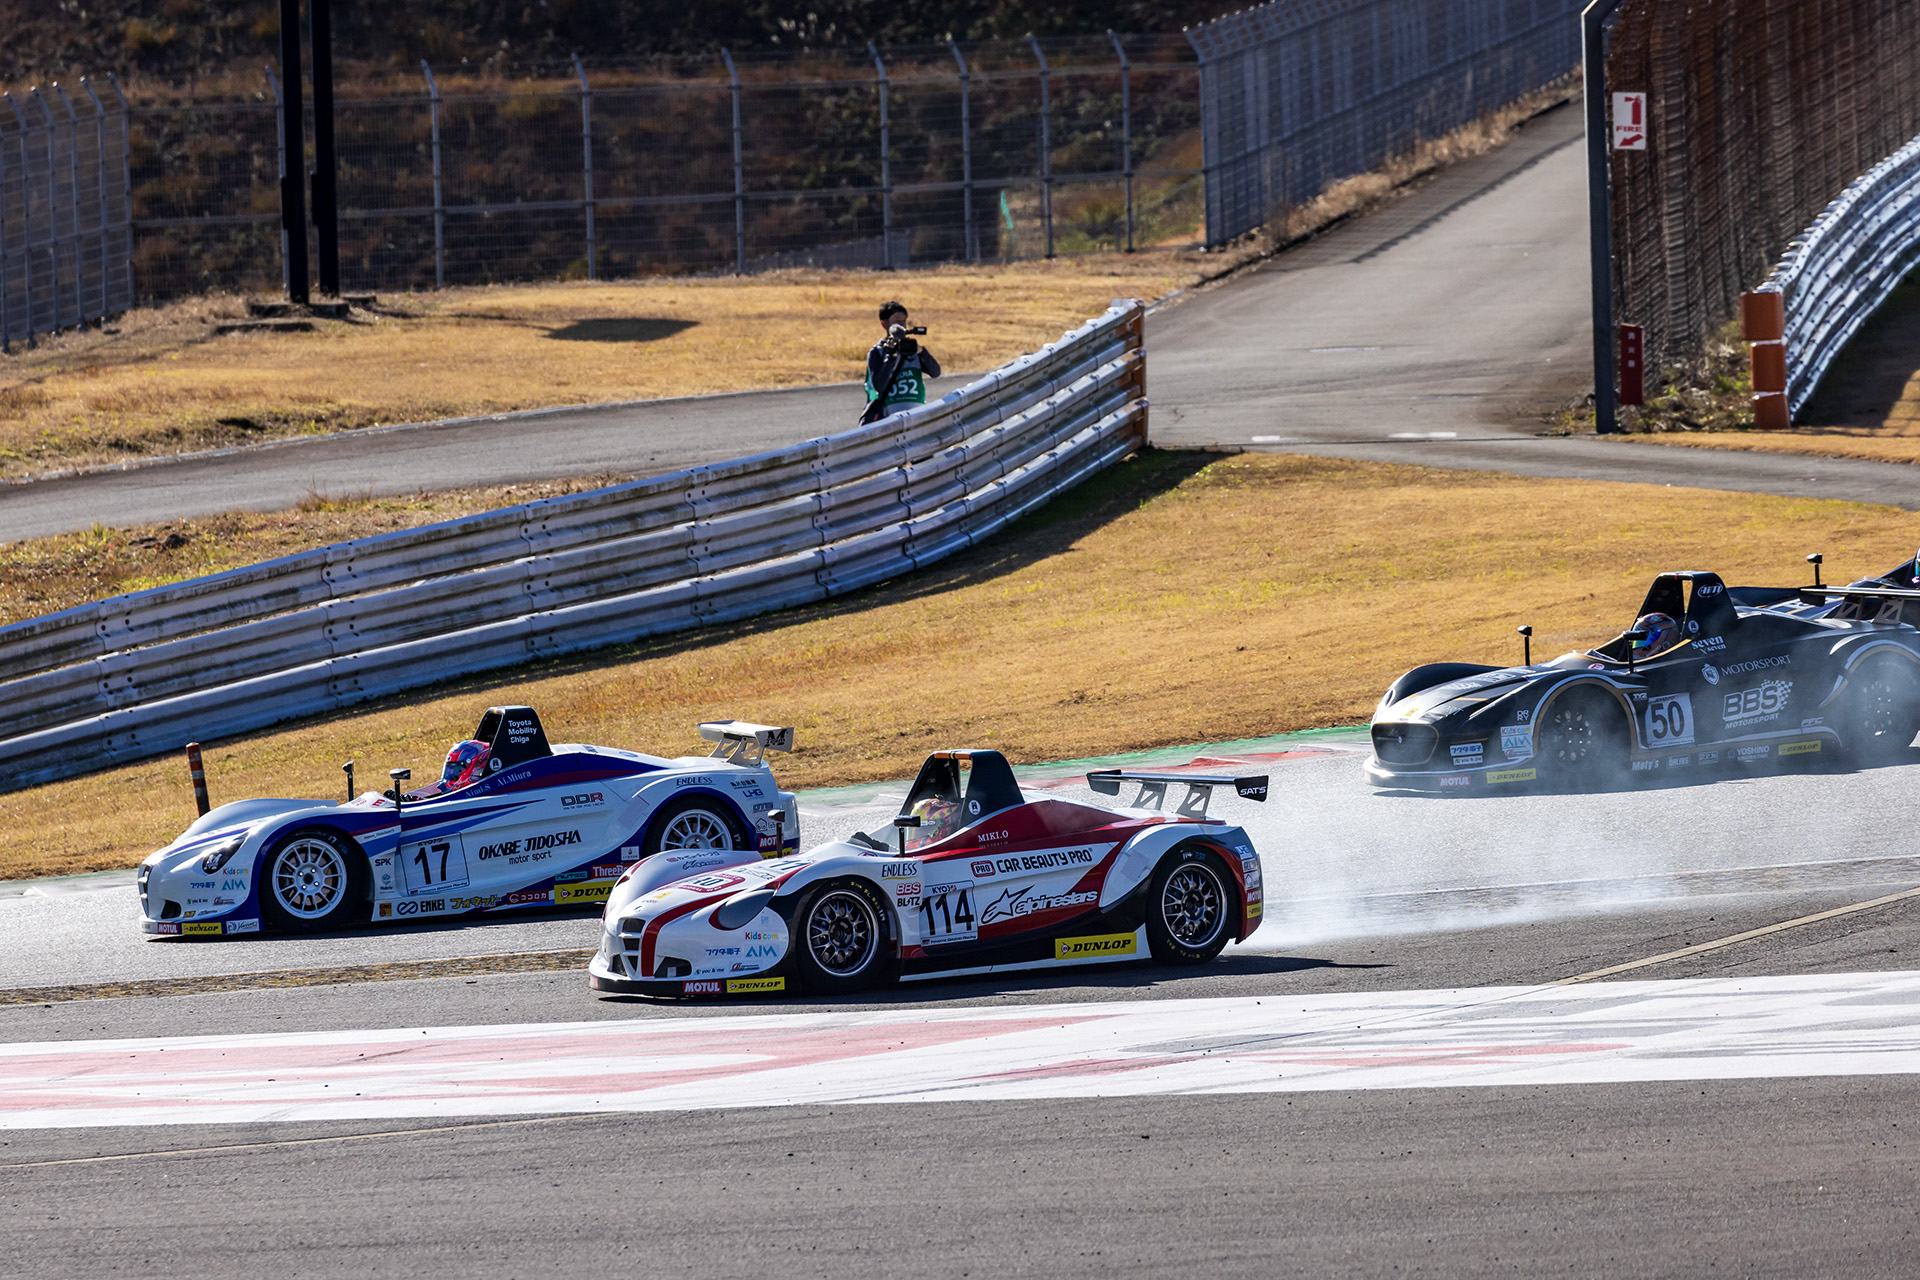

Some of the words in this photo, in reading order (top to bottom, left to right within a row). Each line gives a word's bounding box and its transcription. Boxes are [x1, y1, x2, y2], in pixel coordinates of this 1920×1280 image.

[1721, 654, 1791, 676] MOTORSPORT
[1722, 684, 1781, 722] BBS
[508, 719, 532, 728] Toyota
[1650, 700, 1685, 739] 50
[1725, 713, 1780, 730] MOTORSPORT
[508, 727, 538, 736] Mobility
[510, 736, 530, 744] Shiga
[1737, 745, 1770, 755] YOSHINO
[676, 777, 713, 786] ENDLESS
[1440, 776, 1470, 786] MOTUL
[1496, 771, 1533, 780] DUNLOP
[561, 791, 605, 806] DDR
[977, 830, 1009, 843] MIKI.O
[478, 839, 522, 861] OKABE
[523, 829, 582, 852] JIDOSHA
[374, 858, 392, 867] SPK
[413, 842, 451, 885] 17
[508, 854, 530, 865] motor
[532, 850, 552, 862] sport
[996, 856, 1022, 873] CAR
[1023, 852, 1068, 870] BEAUTY
[1068, 849, 1093, 864] PRO
[881, 862, 918, 878] ENDLESS
[975, 864, 991, 873] PRO
[896, 882, 921, 896] BBS
[420, 899, 445, 912] ENKEI
[897, 896, 920, 908] BLITZ
[1015, 889, 1099, 915] alpinestars
[919, 888, 975, 936] 114
[158, 924, 178, 933] MOTUL
[744, 931, 762, 940] Kids
[762, 932, 779, 940] com
[745, 945, 778, 957] AIM
[1071, 938, 1132, 954] DUNLOP
[684, 982, 720, 993] MOTUL
[737, 980, 781, 989] DUNLOP
